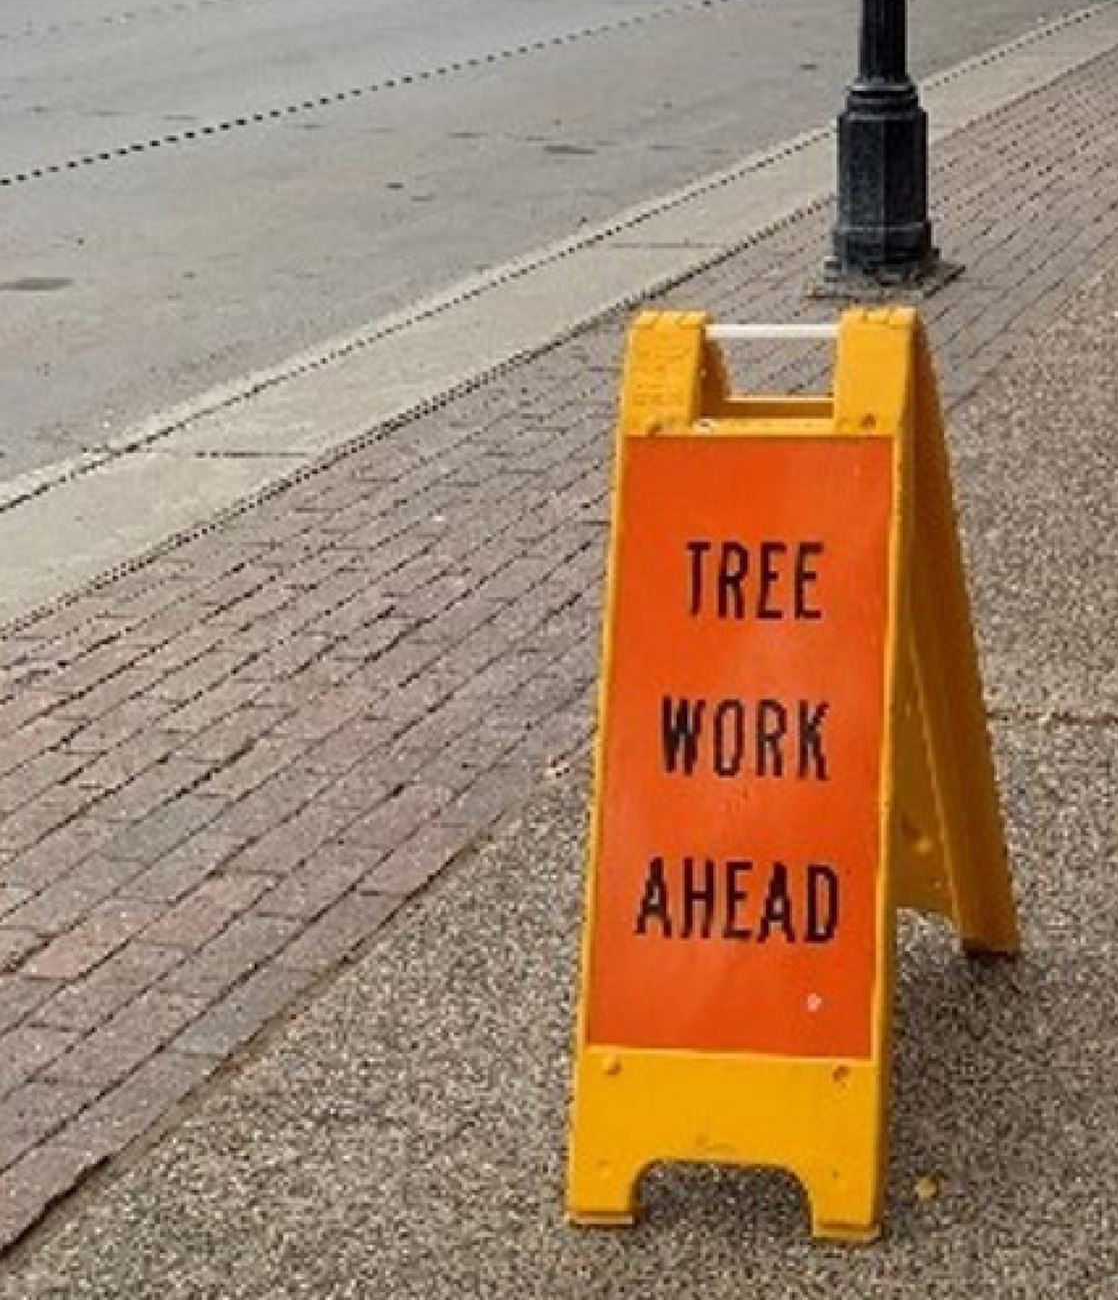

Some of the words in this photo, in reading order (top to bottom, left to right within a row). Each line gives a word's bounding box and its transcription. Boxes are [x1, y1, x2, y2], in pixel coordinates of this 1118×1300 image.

[686, 541, 825, 620] TREE
[661, 694, 829, 781] WORK
[634, 856, 841, 943] AHEAD
